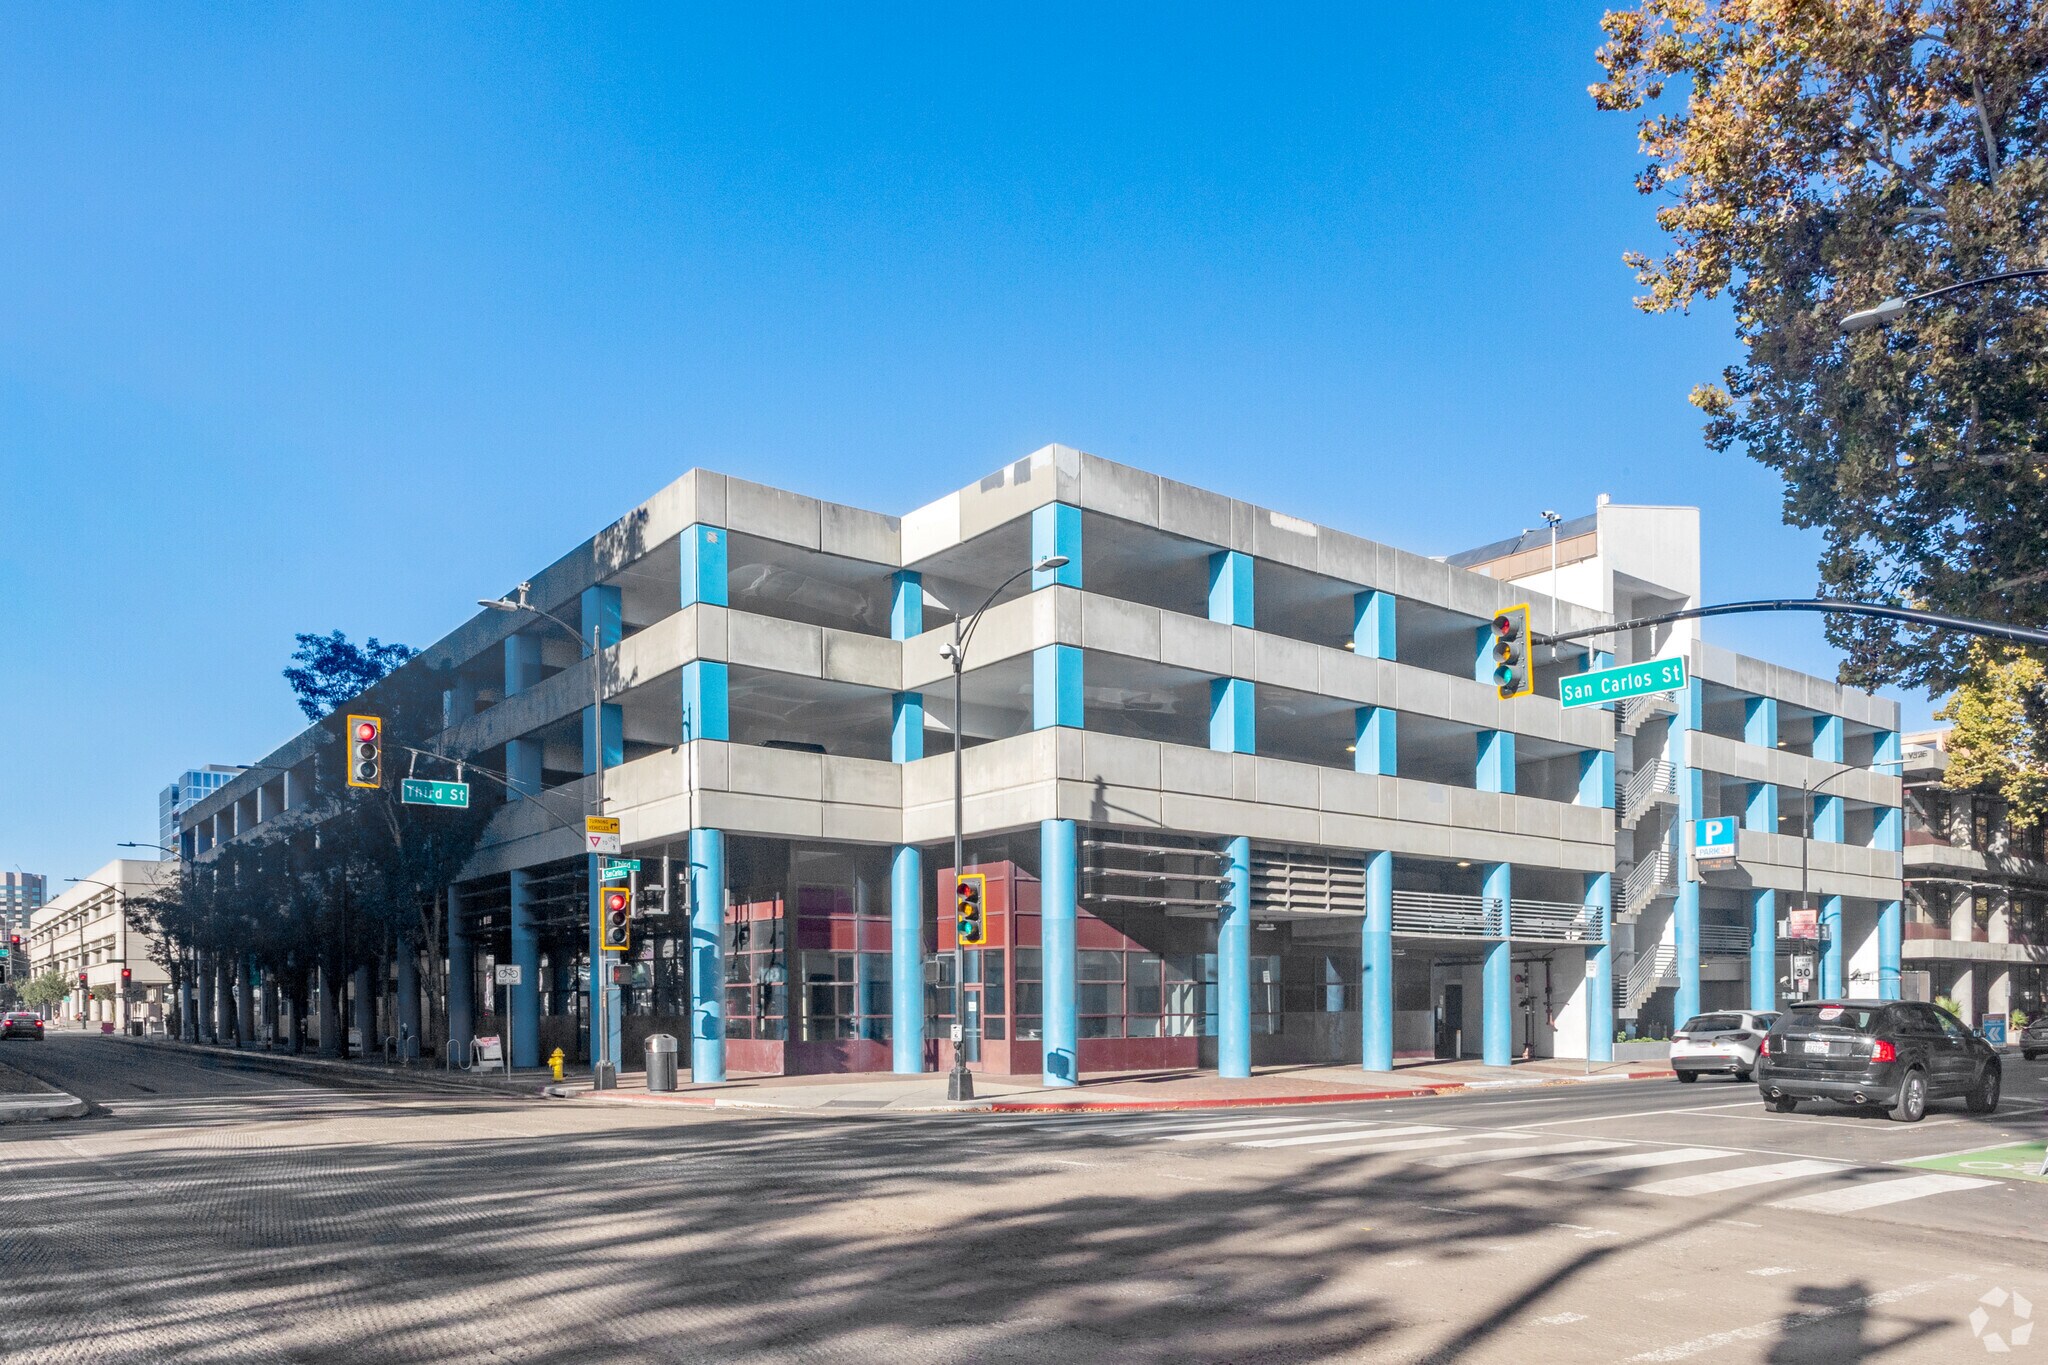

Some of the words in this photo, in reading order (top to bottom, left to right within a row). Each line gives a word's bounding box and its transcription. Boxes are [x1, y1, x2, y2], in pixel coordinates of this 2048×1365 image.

[1564, 684, 1592, 701] San
[1601, 673, 1652, 694] Carlos
[1662, 664, 1680, 683] St
[407, 785, 442, 799] Third
[450, 788, 465, 801] St
[1705, 820, 1723, 845] P
[1796, 968, 1811, 977] 30
